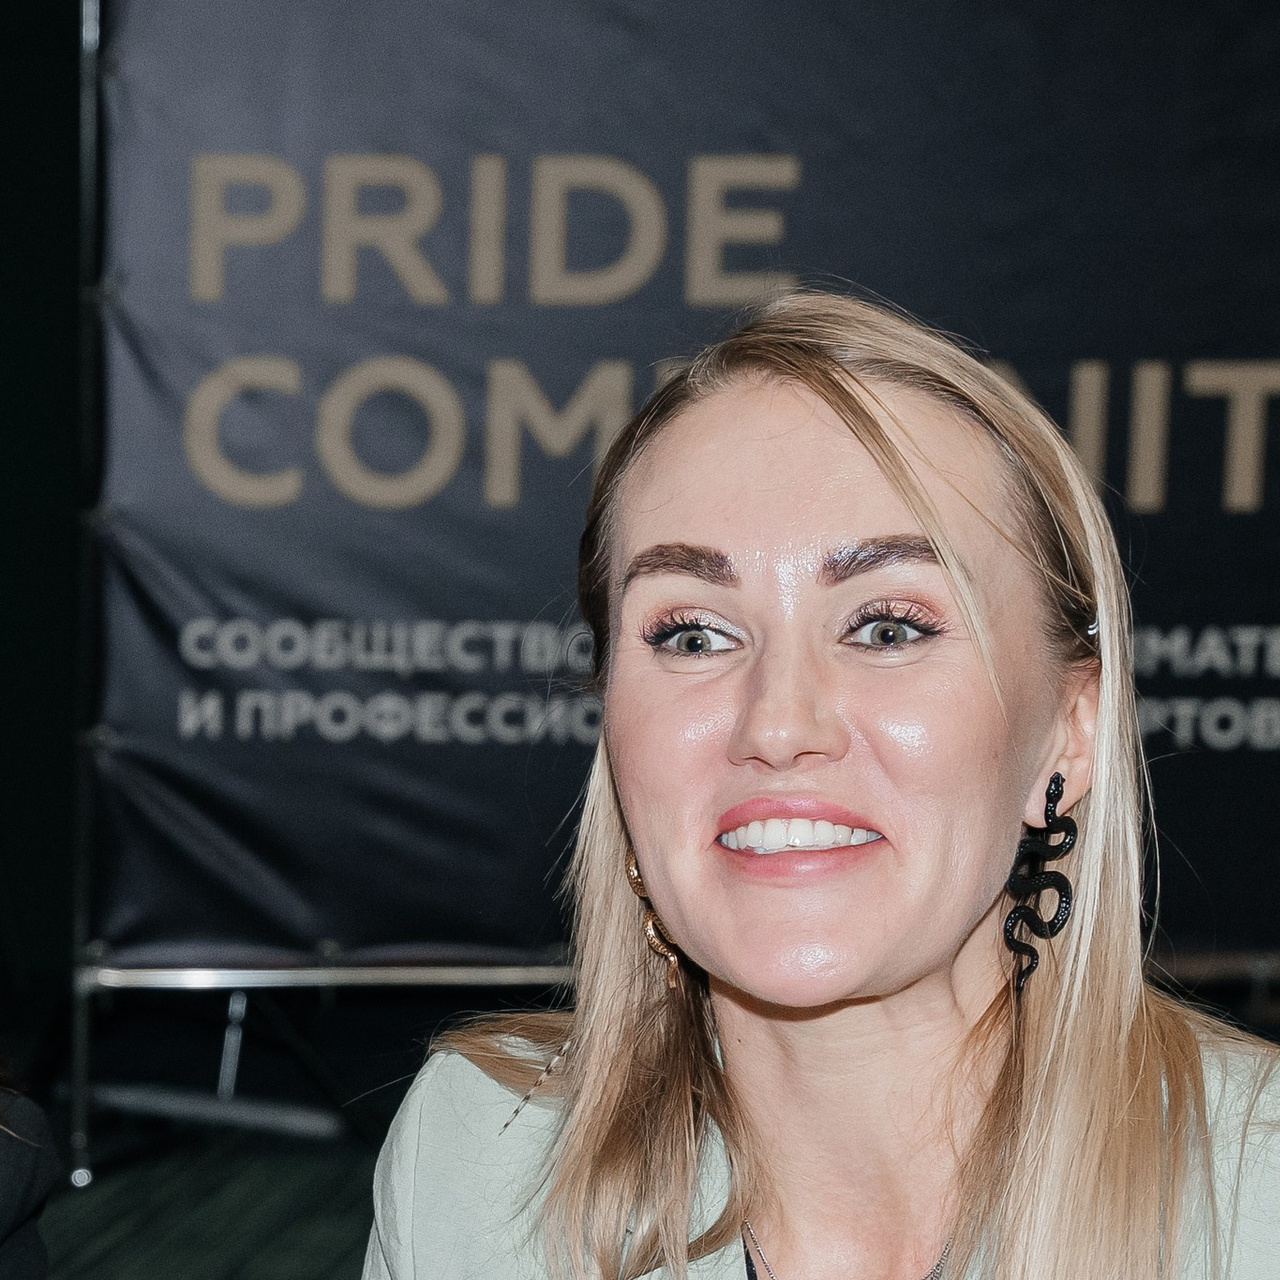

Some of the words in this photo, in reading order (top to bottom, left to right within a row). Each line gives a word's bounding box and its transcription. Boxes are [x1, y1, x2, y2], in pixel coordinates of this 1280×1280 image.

[189, 153, 802, 308] PRIDE
[179, 689, 224, 742] И
[235, 691, 605, 745] ПРОФЕССИО
